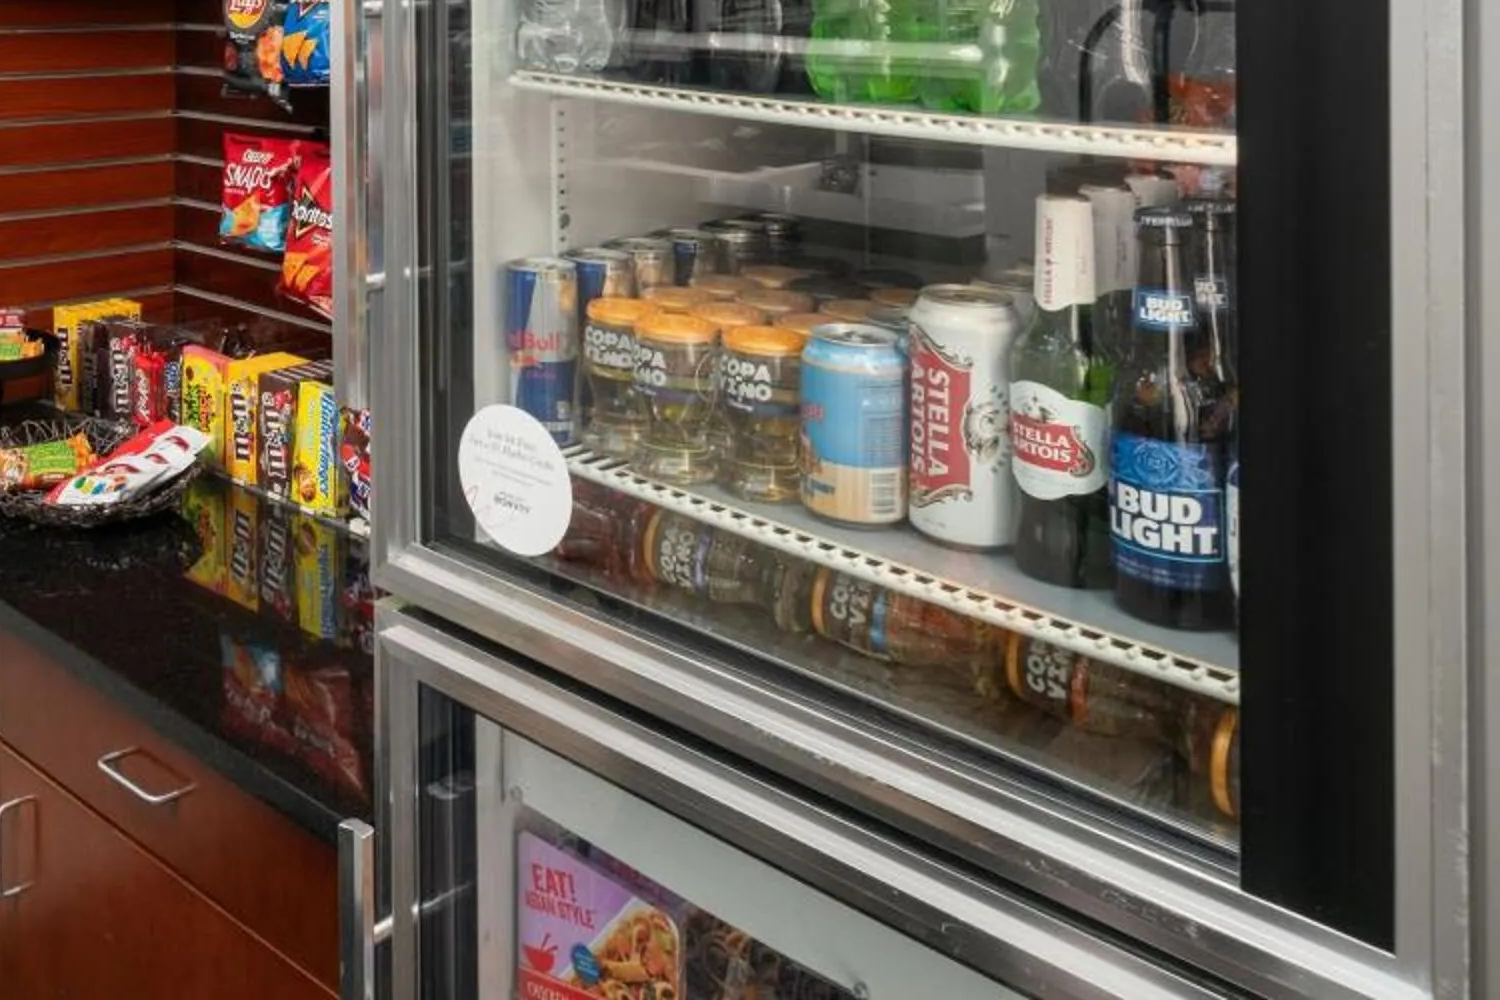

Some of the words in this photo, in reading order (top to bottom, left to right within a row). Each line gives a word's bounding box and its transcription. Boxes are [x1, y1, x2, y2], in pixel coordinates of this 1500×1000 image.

[585, 325, 634, 351] COPA
[910, 362, 926, 474] ARTOIS
[927, 367, 950, 478] STELLA
[1116, 481, 1203, 526] BUD
[1109, 505, 1218, 556] LIGHT
[531, 861, 577, 903] EAT!
